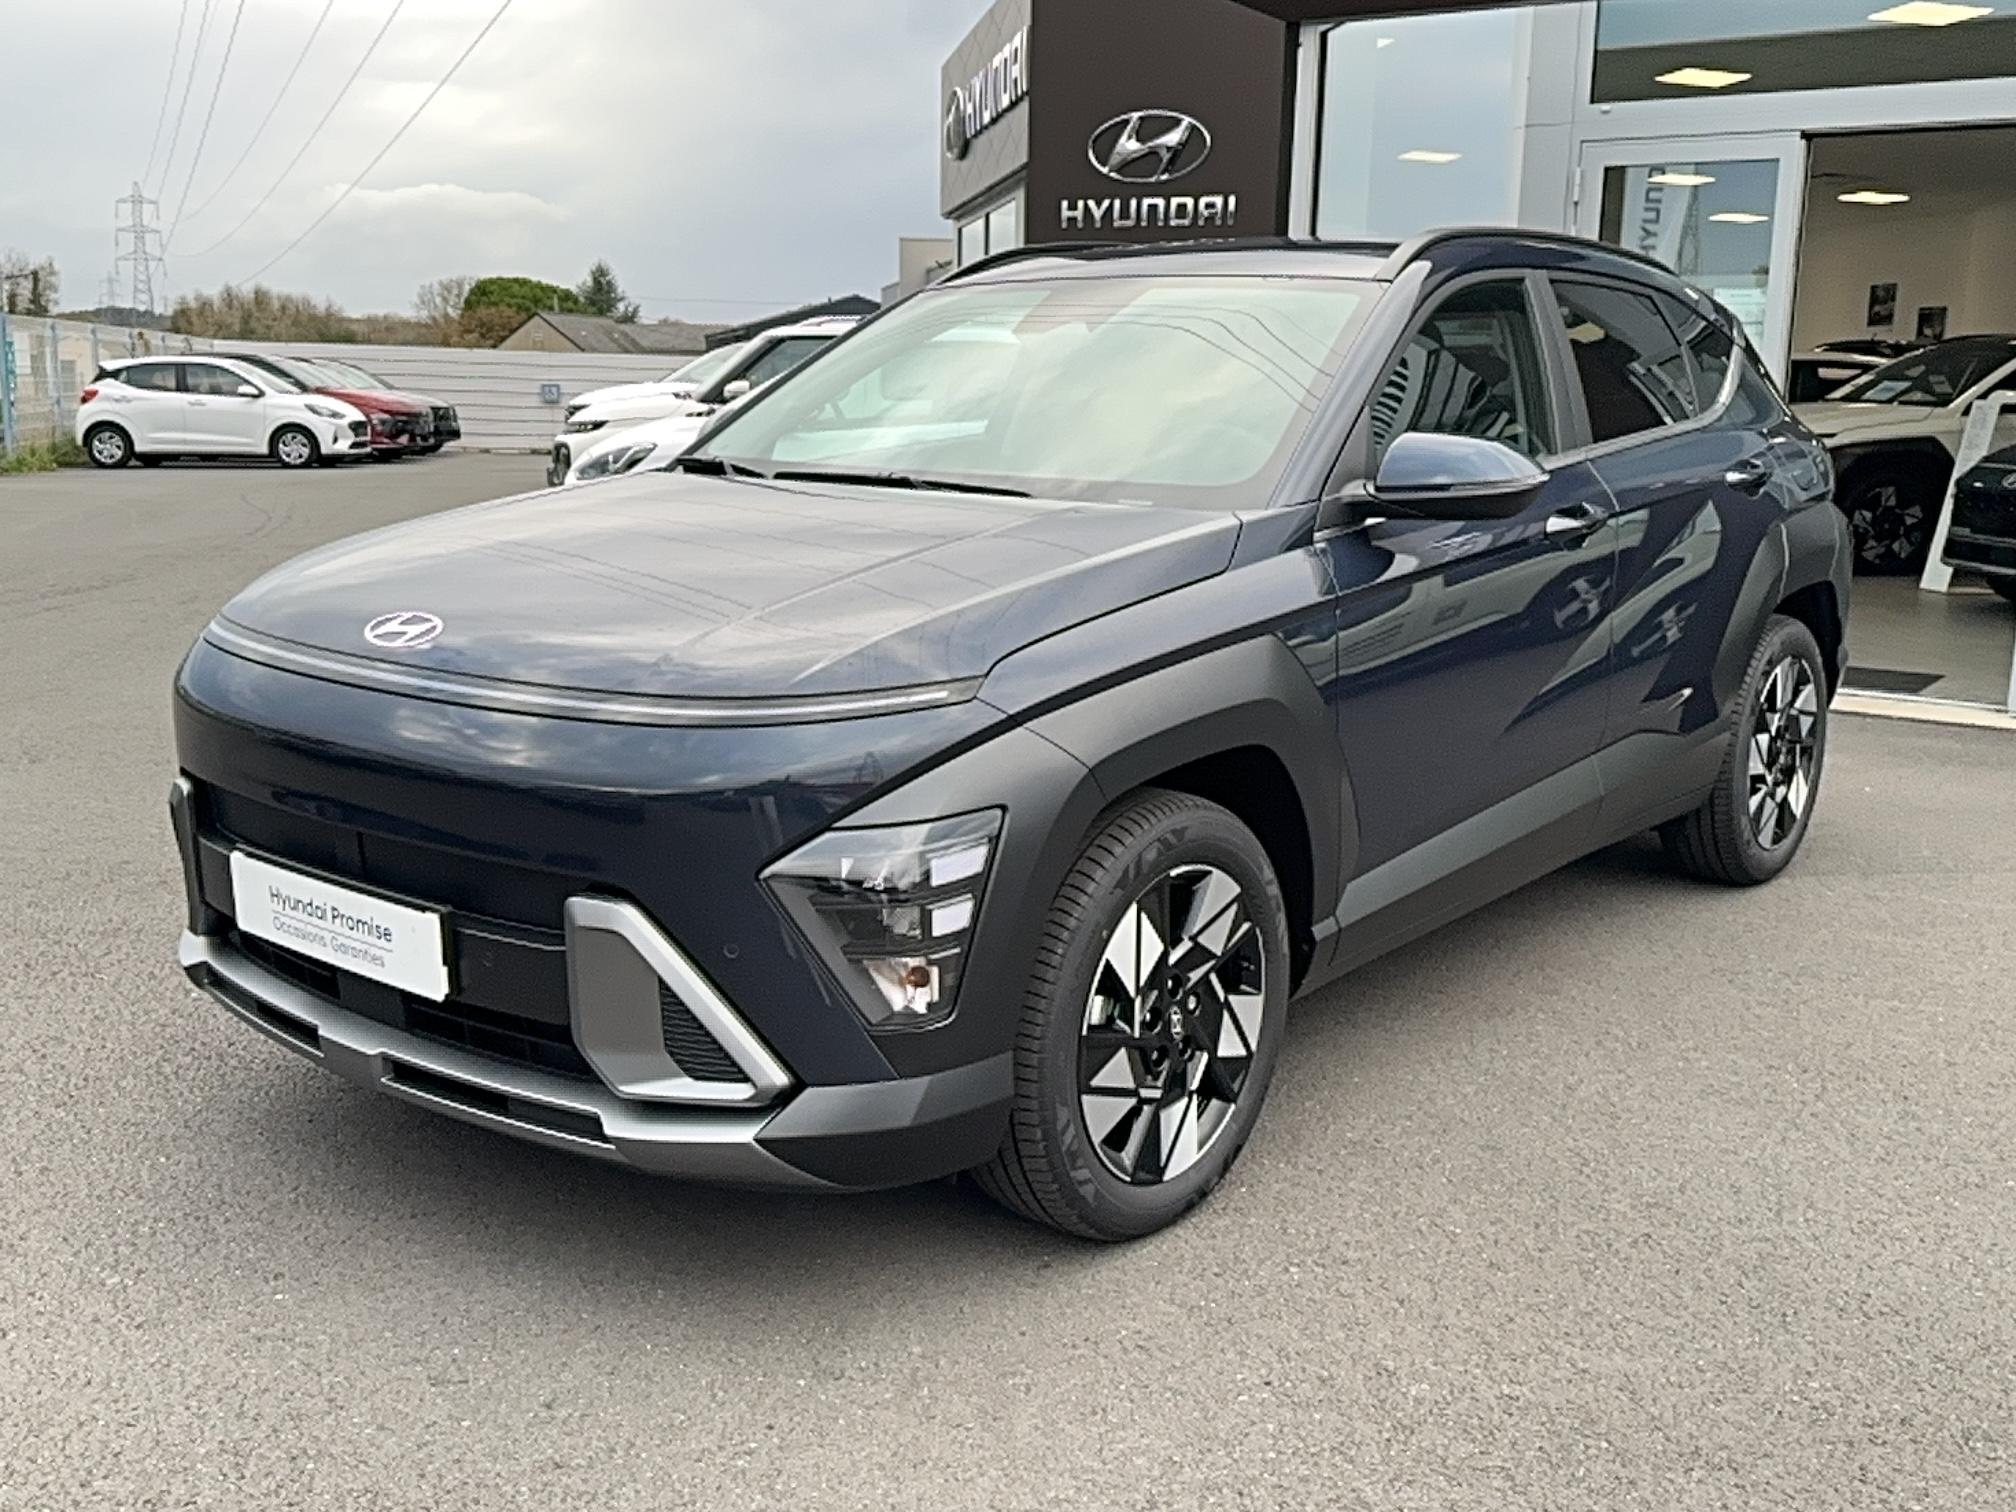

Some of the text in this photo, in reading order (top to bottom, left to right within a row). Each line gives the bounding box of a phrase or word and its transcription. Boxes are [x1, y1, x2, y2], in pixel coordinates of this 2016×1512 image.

[965, 25, 1028, 139] HYUNDAI
[1060, 194, 1237, 229] HYUNDAI
[268, 885, 392, 942] Hyundai Promise
[272, 916, 385, 968] Occasions Garanties
